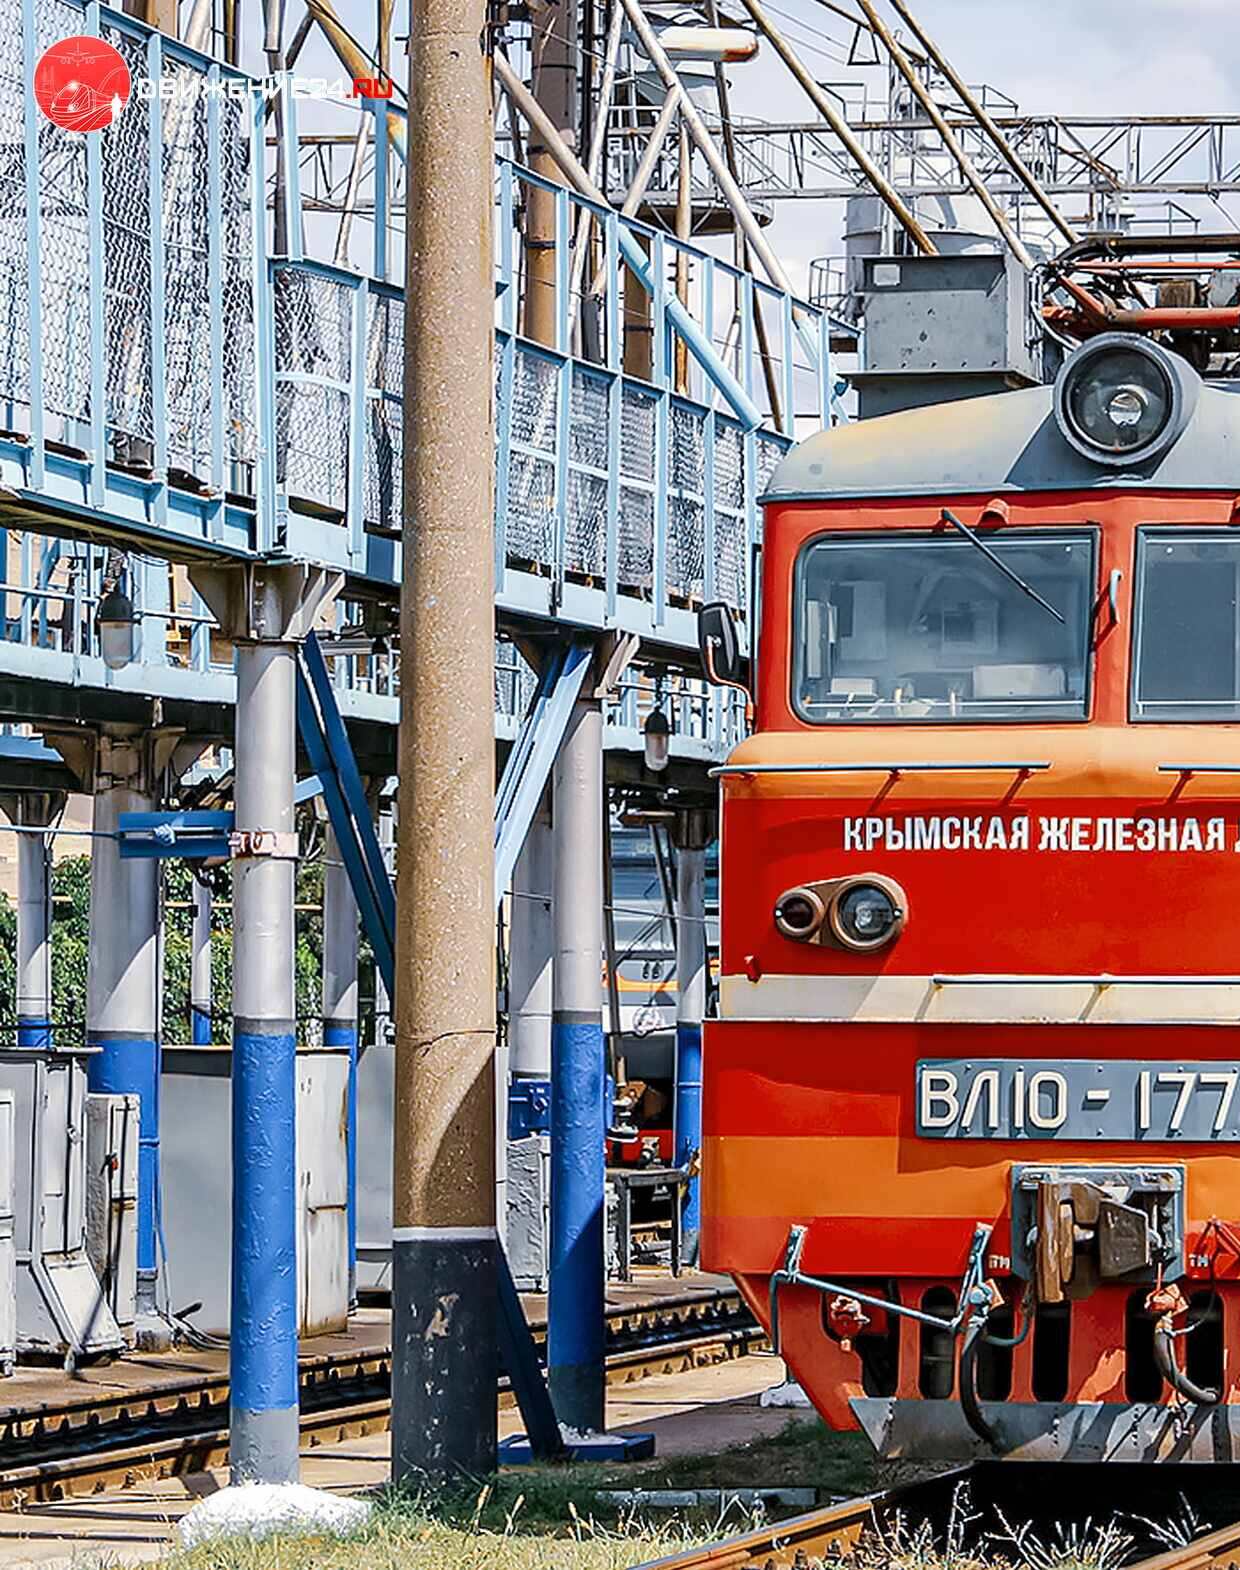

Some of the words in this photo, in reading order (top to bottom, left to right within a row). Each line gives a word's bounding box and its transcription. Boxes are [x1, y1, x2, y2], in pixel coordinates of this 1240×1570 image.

[844, 815, 1029, 852] КРЫМСКАЯ
[1038, 816, 1226, 852] ЖЕЛЕЗНАЯ
[920, 1070, 1068, 1128] ВЛ10
